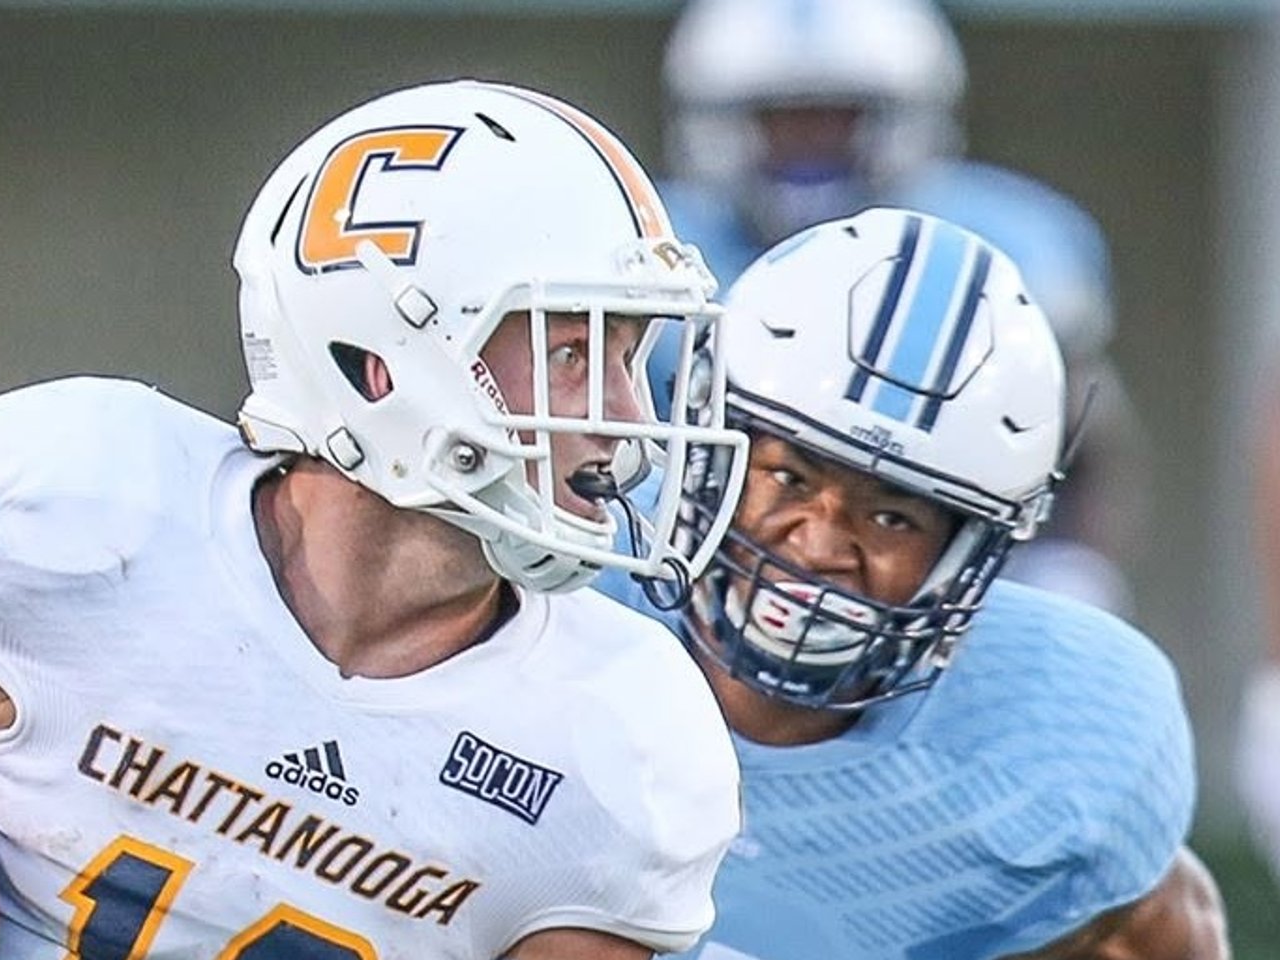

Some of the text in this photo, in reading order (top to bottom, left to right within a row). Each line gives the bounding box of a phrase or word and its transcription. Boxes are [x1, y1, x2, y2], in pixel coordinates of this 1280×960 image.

[295, 124, 466, 274] C
[77, 724, 481, 926] CHATTANOOGA
[265, 760, 360, 806] adidas
[442, 734, 564, 822] SOCON
